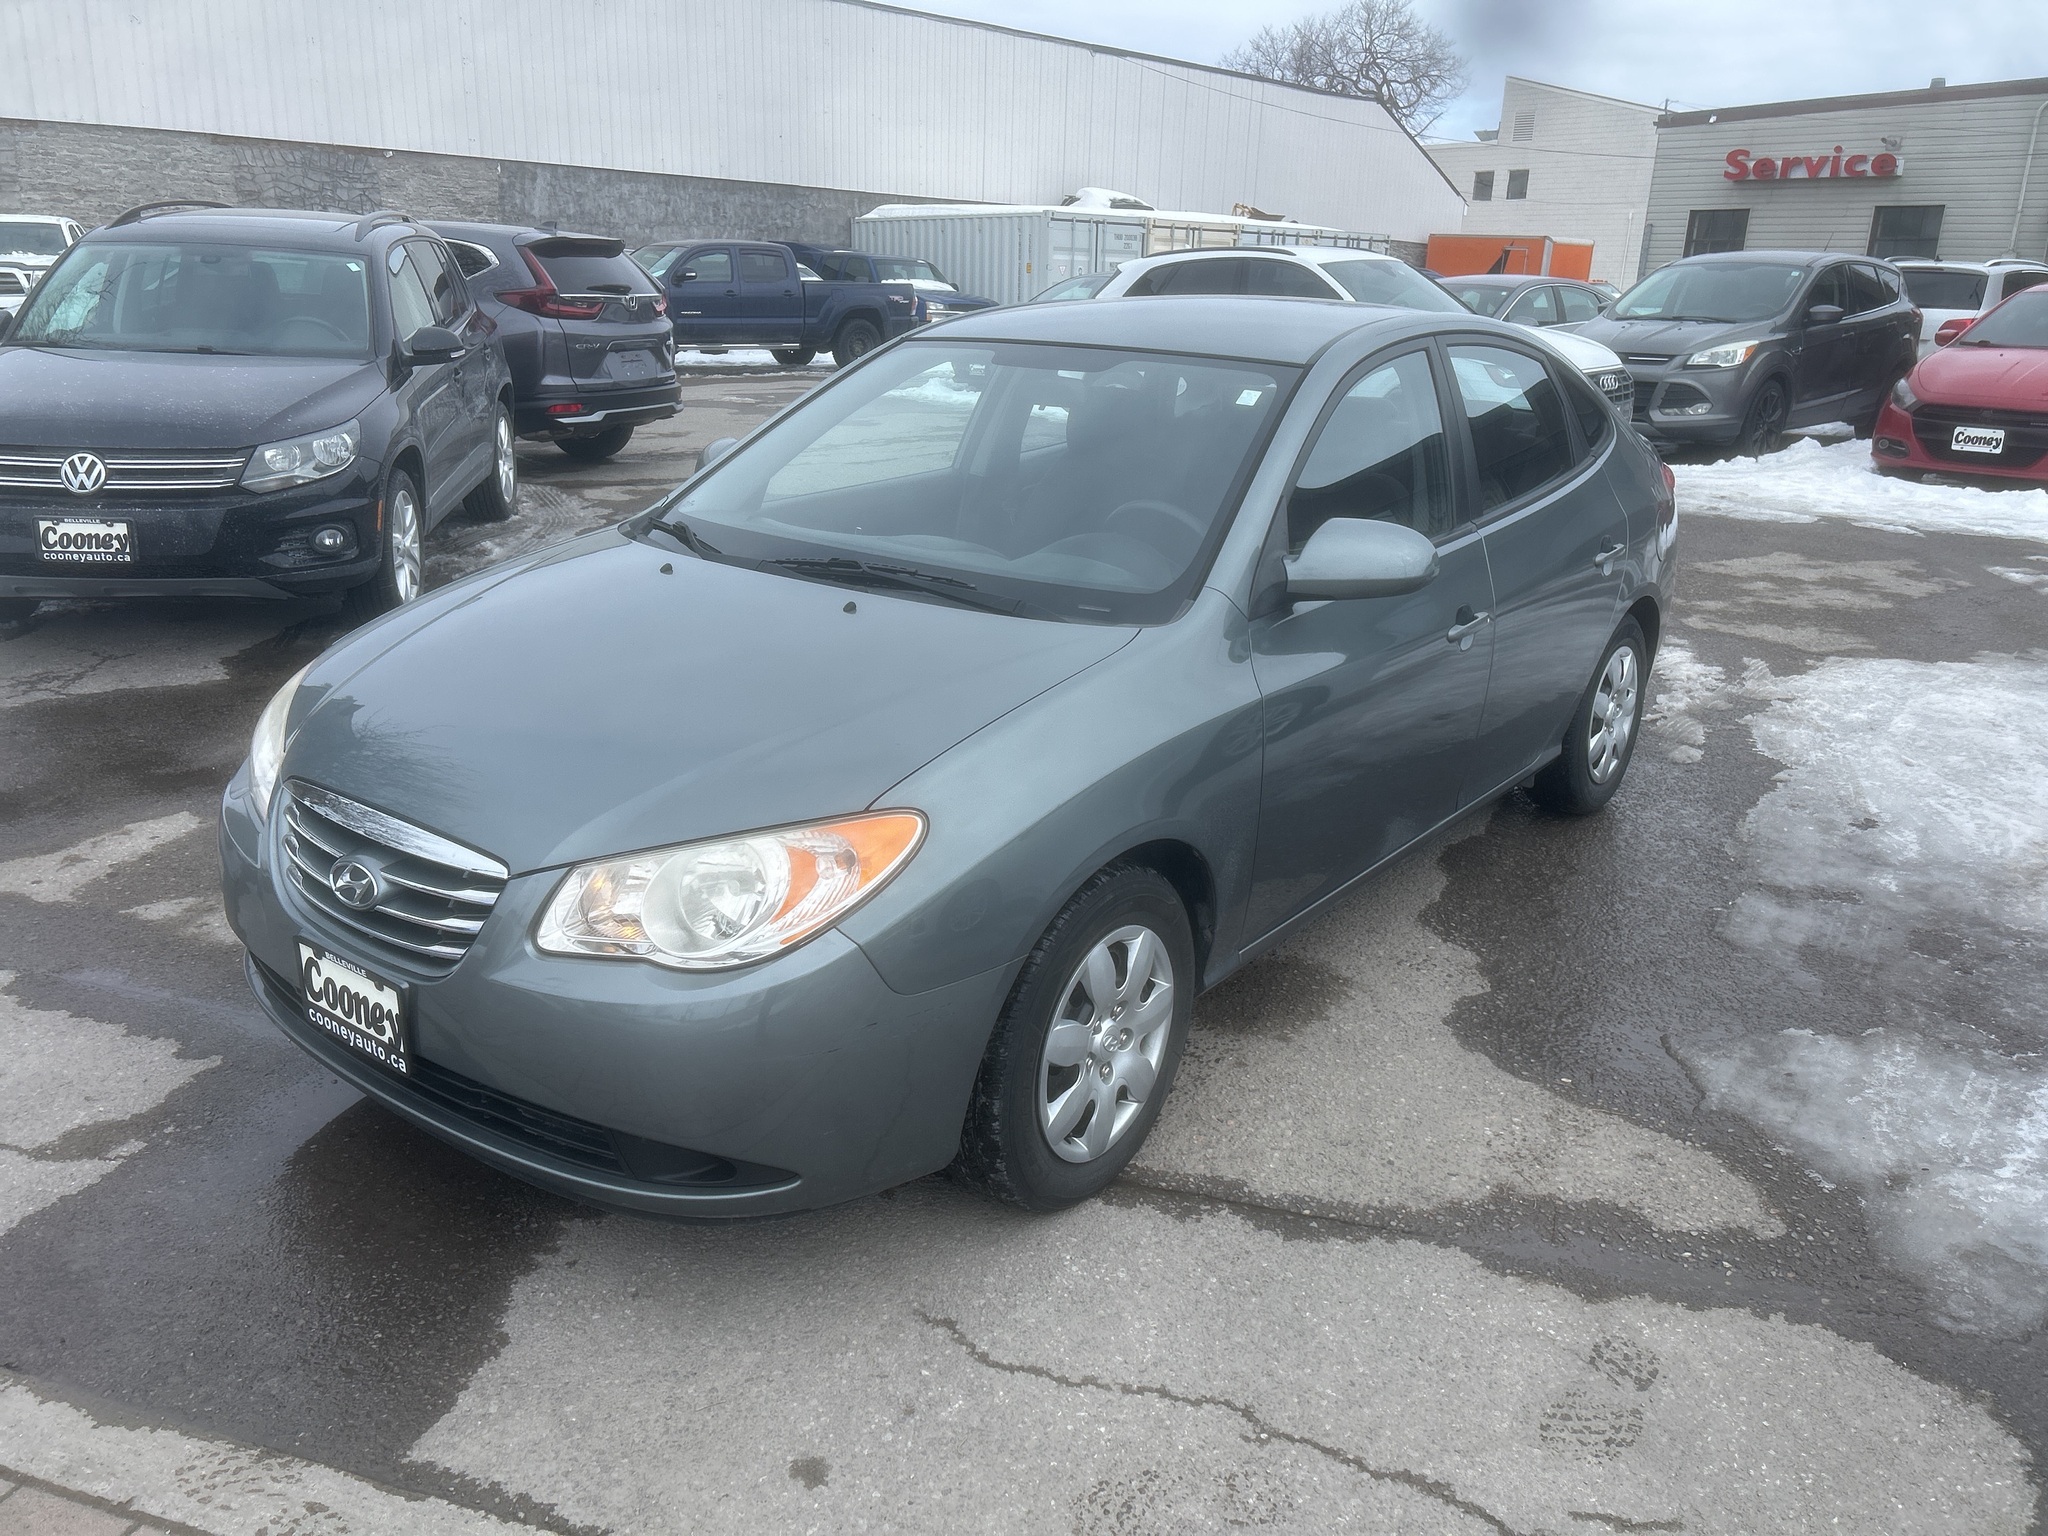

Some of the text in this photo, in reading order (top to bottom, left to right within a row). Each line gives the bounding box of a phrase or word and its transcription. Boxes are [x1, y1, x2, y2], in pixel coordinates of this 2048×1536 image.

[1723, 145, 1897, 181] Service
[1954, 431, 2002, 450] Cooney
[42, 526, 129, 553] Cooney
[43, 552, 131, 563] cooneyauto.ca
[324, 951, 367, 978] BELLEVILLE
[303, 956, 402, 1050] Cooney
[308, 1008, 407, 1073] cooneyauto.ca
